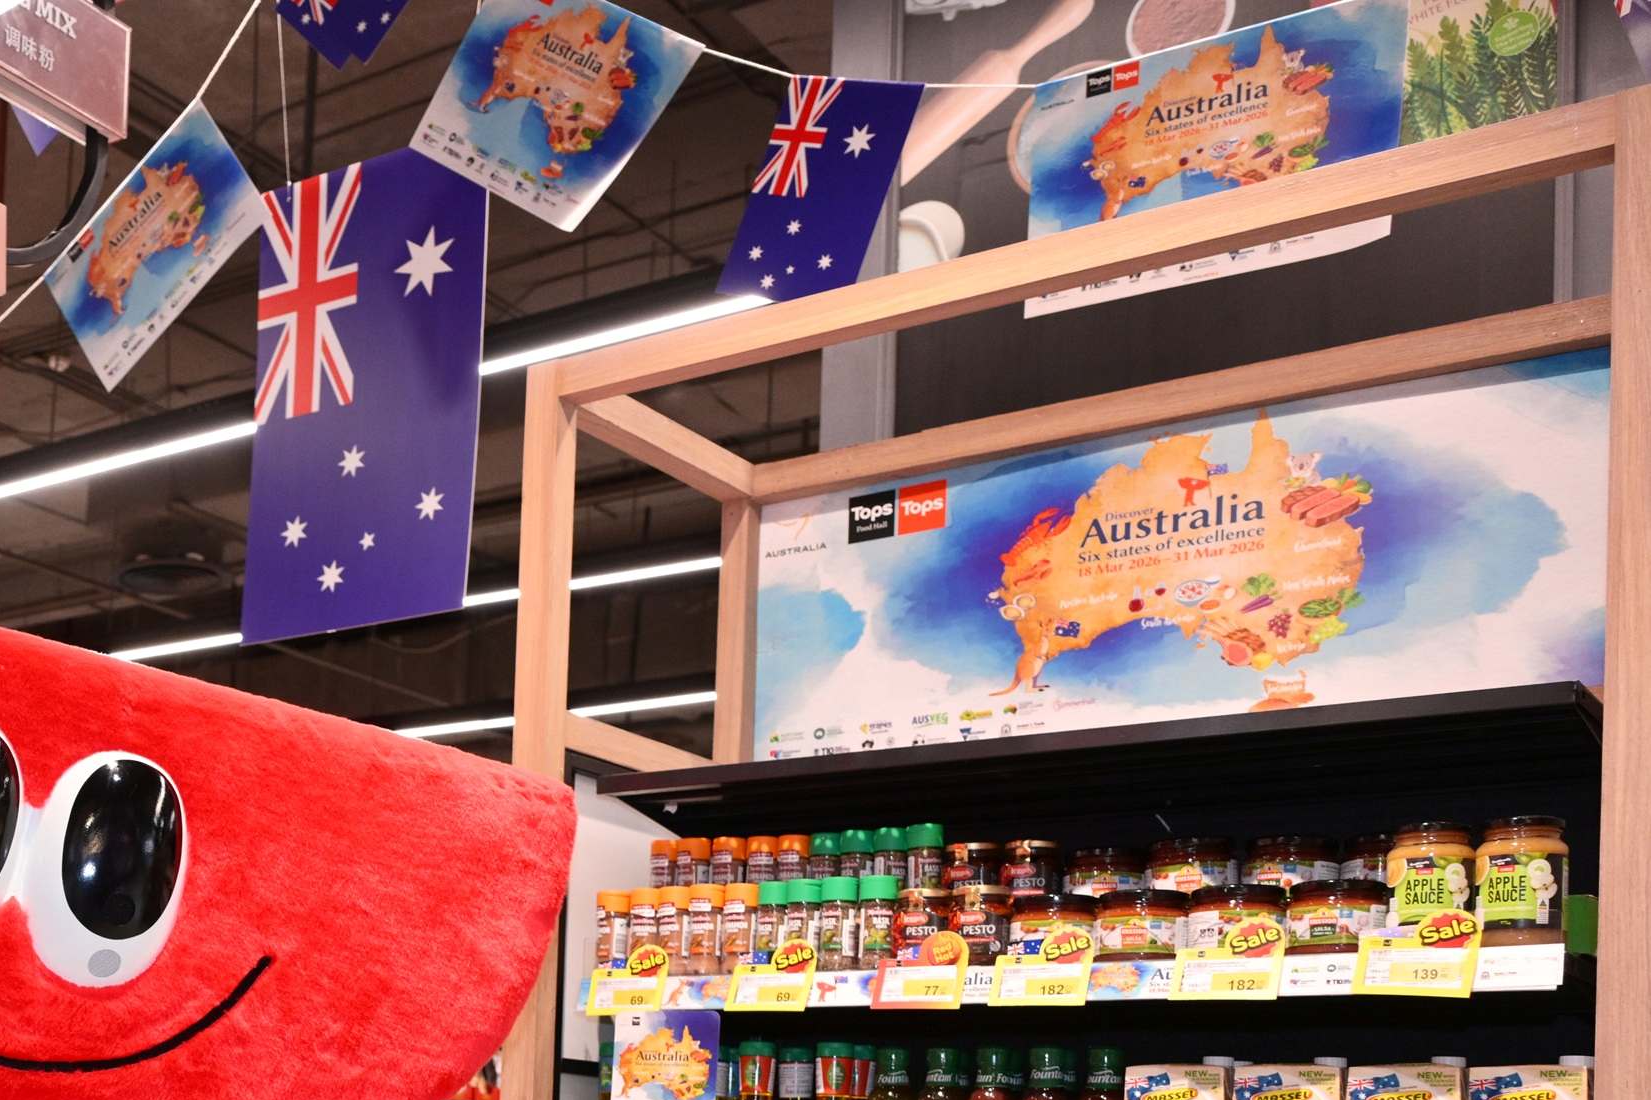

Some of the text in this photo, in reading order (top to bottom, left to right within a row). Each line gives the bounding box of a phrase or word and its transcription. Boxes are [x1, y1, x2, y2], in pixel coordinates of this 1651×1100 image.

[35, 3, 77, 39] MIX
[4, 24, 55, 72] 调味粉
[537, 32, 603, 74] Australia
[1146, 81, 1269, 126] Australia
[104, 188, 166, 256] Australia
[851, 502, 893, 522] Tops
[901, 497, 944, 517] Tops
[1104, 506, 1155, 523] Discover
[856, 521, 888, 533] Food Hall
[1079, 493, 1266, 548] Australia
[765, 542, 827, 559] AUSTRALIA
[1077, 525, 1266, 564] Six states of excellence
[1013, 876, 1046, 888] PESTO
[1405, 878, 1444, 892] APPLE
[1487, 875, 1527, 890] APPLE
[1405, 891, 1444, 906] SAUCE
[1487, 888, 1527, 904] SAUCE
[906, 925, 938, 937] PESTO
[963, 924, 996, 936] PESTO
[1420, 918, 1475, 946] Sale
[1045, 936, 1091, 961] Sale
[1231, 926, 1282, 955] Sale
[629, 953, 666, 975] Sale
[775, 948, 814, 970] Sale
[1412, 968, 1439, 980] 139
[924, 985, 940, 996] 77
[1040, 984, 1065, 996] 182
[630, 995, 644, 1006] 69
[636, 1050, 690, 1063] Australia
